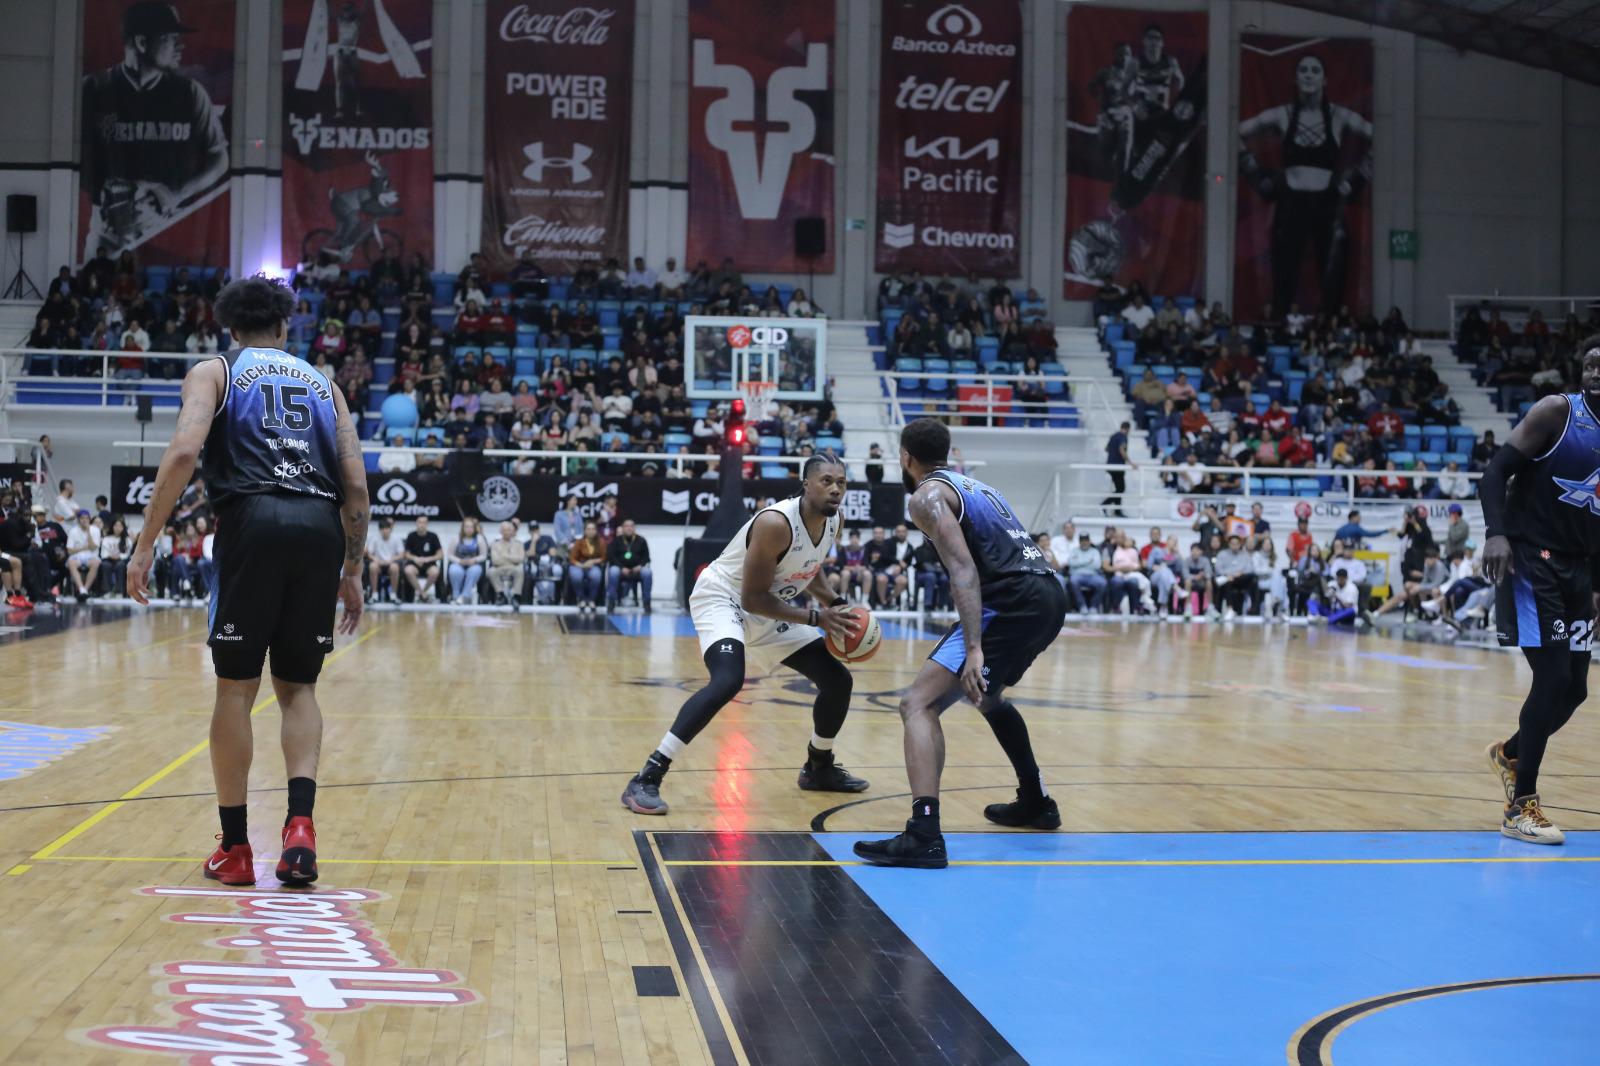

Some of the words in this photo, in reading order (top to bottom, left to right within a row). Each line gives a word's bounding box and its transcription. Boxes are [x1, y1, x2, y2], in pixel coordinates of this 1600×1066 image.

[500, 4, 616, 46] Coca-Cola
[892, 36, 949, 54] Banco
[951, 39, 1016, 57] Azteca
[506, 72, 607, 97] POWER
[895, 75, 1010, 113] telcel
[551, 98, 608, 121] ADE
[904, 136, 999, 160] KIA
[509, 187, 551, 198] UNDER
[903, 167, 998, 194] Pacific
[503, 214, 607, 247] Caliente
[921, 226, 1014, 250] Chevron
[751, 327, 788, 345] CID
[251, 351, 297, 365] Mobil
[233, 363, 332, 402] RICHARDSON
[260, 382, 312, 431] 15
[558, 482, 619, 498] KIA
[1551, 632, 1569, 641] MEGA
[145, 886, 465, 1009] Huichol
